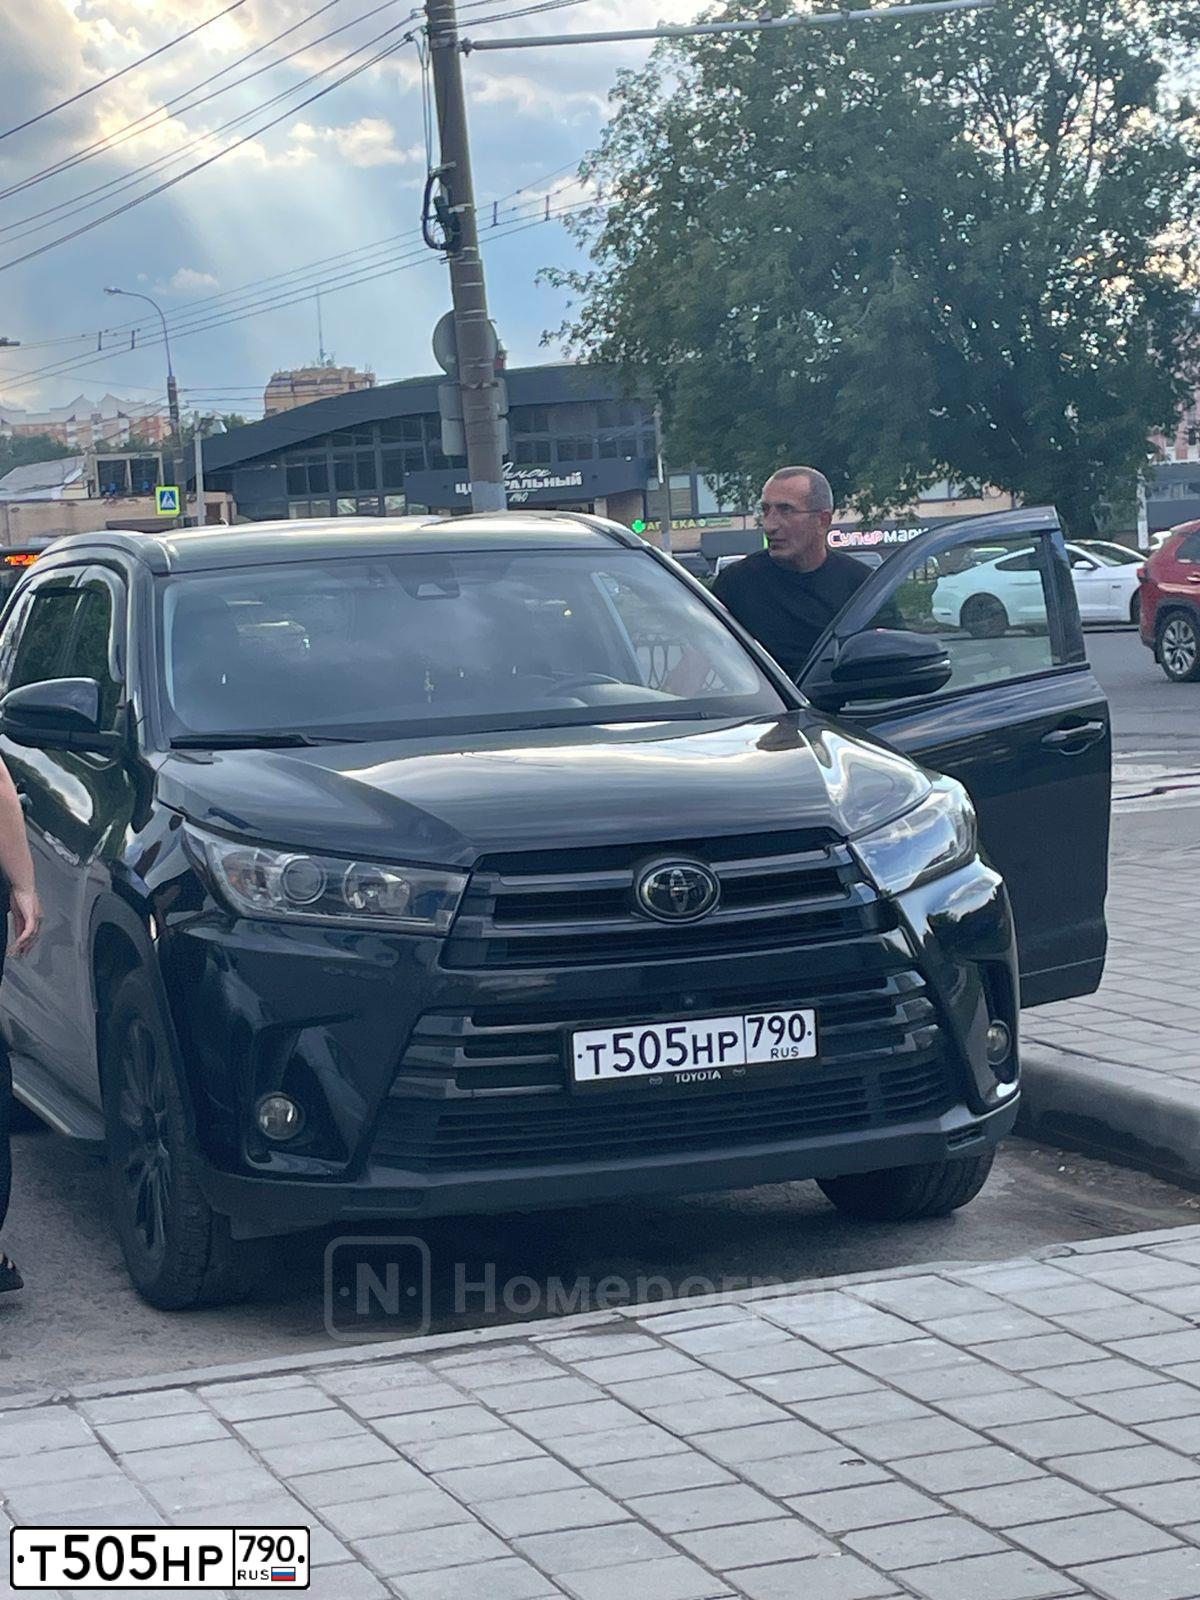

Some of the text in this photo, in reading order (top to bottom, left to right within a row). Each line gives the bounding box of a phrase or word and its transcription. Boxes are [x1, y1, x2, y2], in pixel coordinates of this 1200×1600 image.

[455, 471, 582, 495] ЦРАЛЬНЫЙ
[646, 518, 697, 530] АПЕКА
[586, 1013, 807, 1076] Т505НР 790
[770, 1046, 799, 1060] RUS
[674, 1070, 722, 1084] TOYOTA
